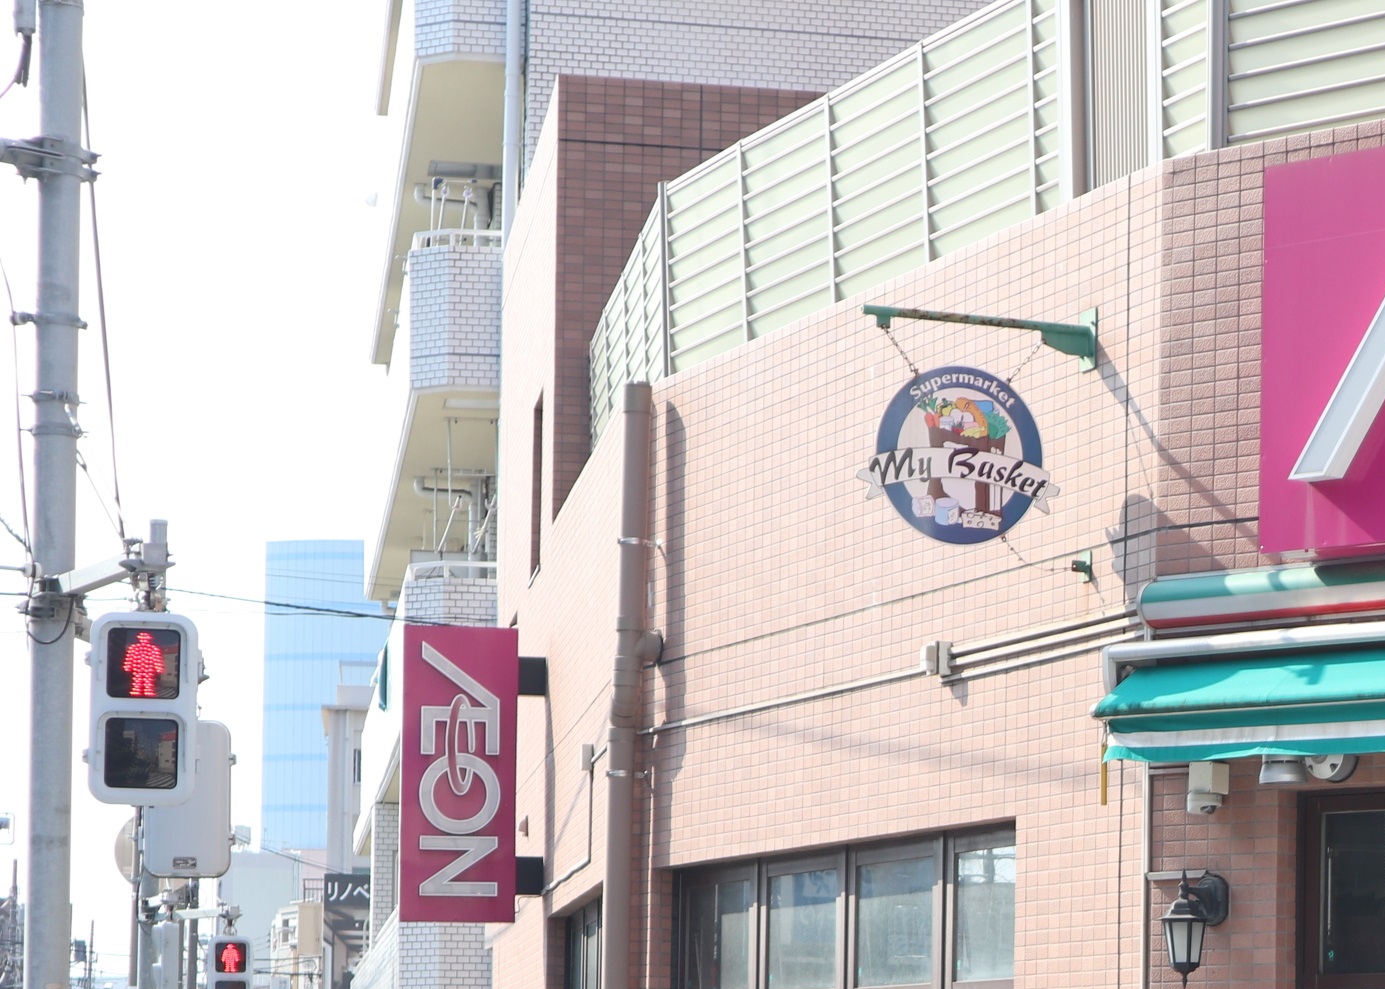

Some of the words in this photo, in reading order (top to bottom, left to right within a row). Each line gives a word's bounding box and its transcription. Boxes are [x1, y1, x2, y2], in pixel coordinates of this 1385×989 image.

[910, 372, 1016, 409] Supermarket
[869, 447, 932, 484] My
[948, 447, 1049, 499] Basket
